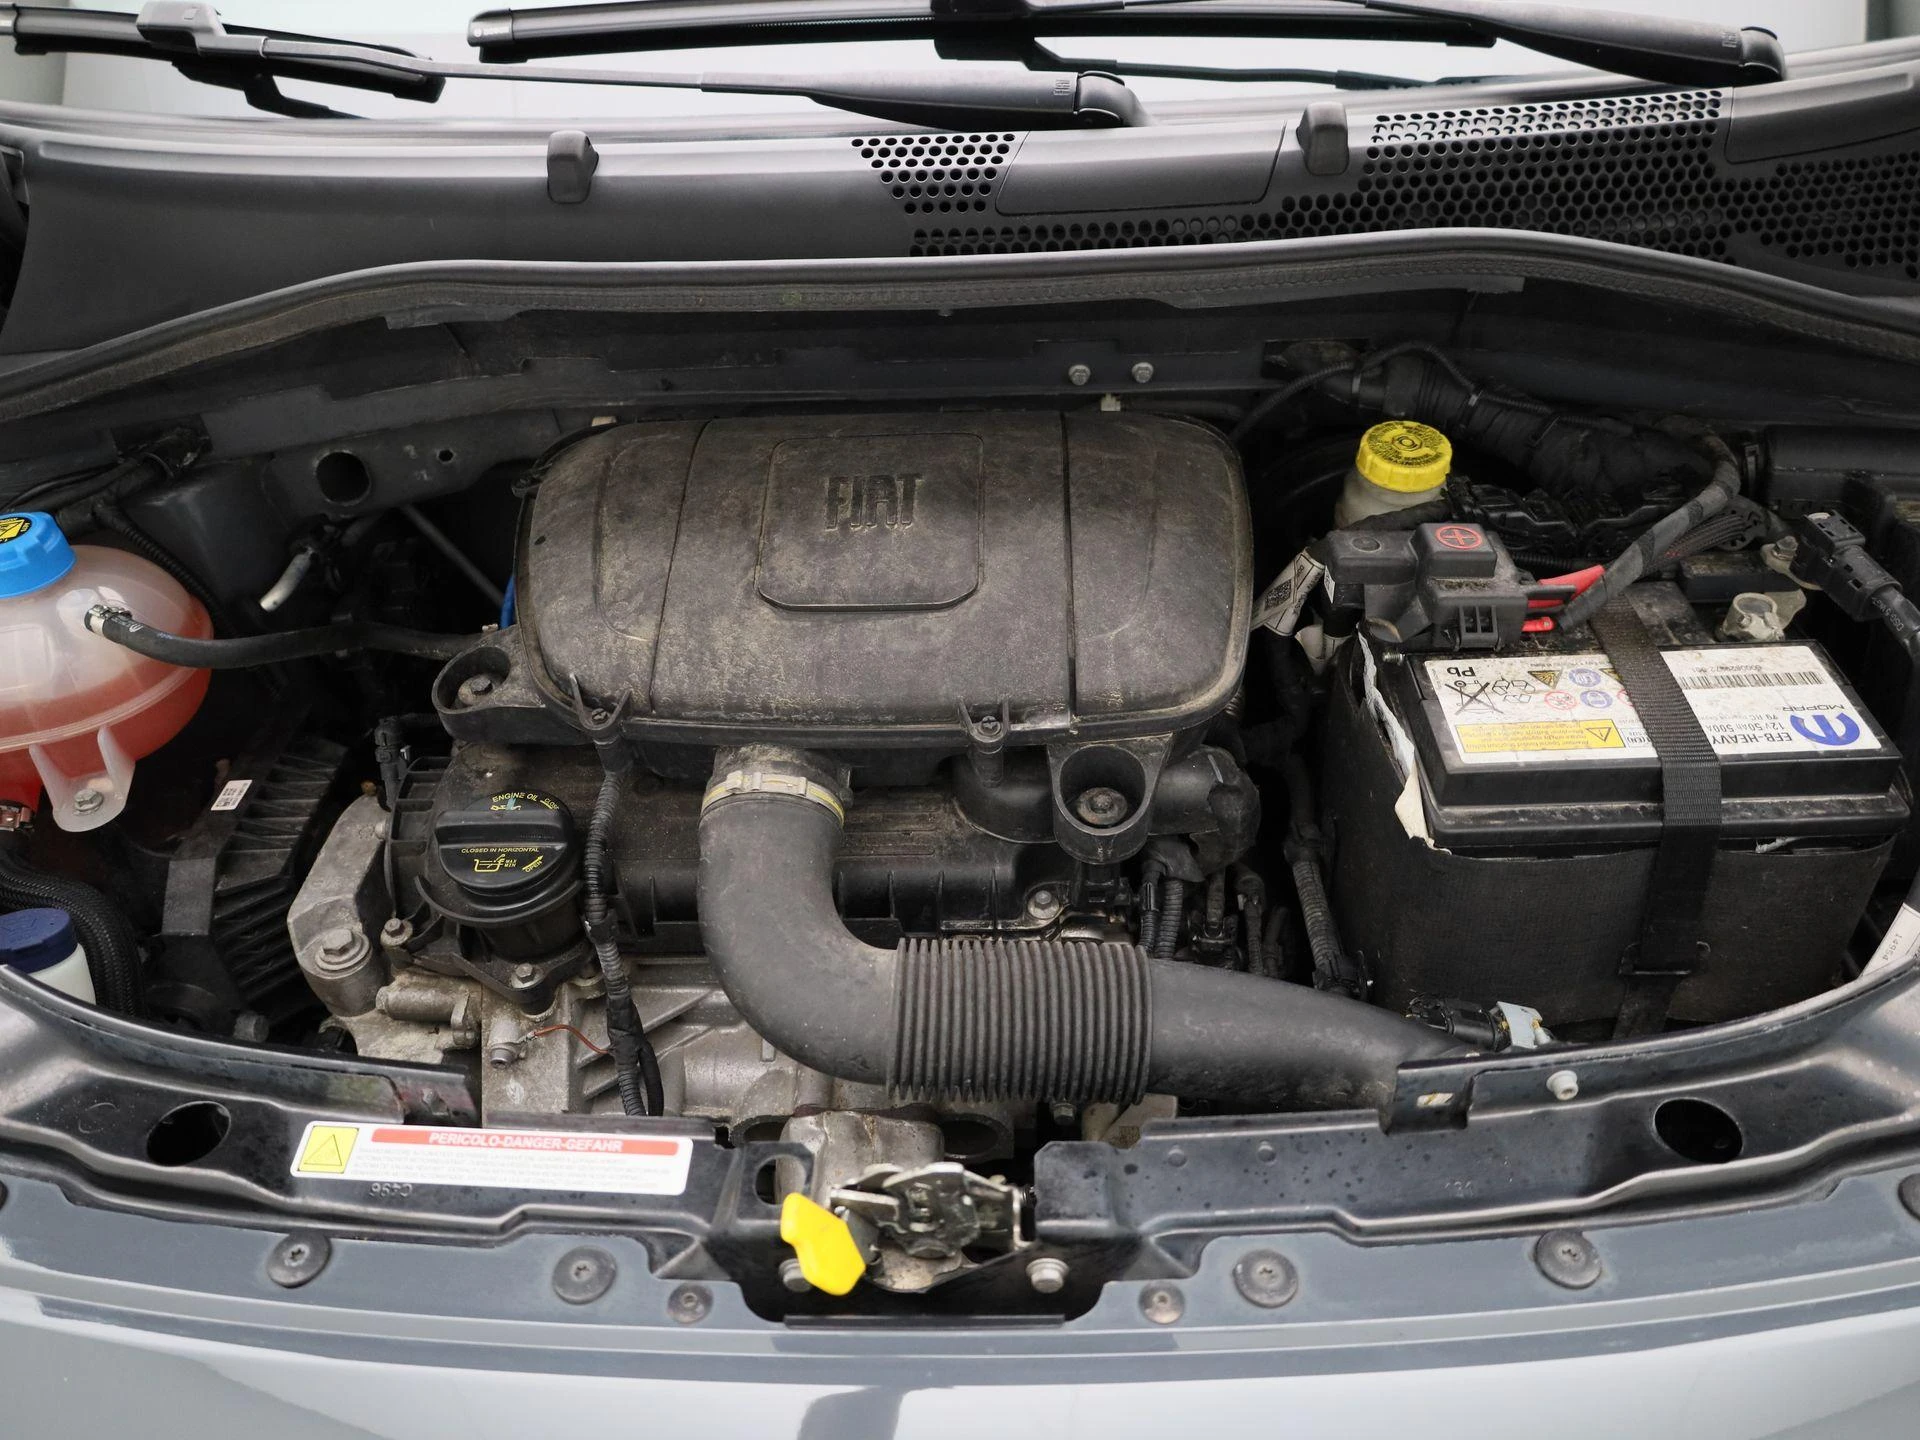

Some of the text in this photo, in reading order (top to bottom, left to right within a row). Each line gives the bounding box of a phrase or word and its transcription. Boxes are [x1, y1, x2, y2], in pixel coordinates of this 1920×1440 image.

[823, 472, 924, 532] FIAT
[1446, 666, 1477, 677] Pb
[1782, 704, 1845, 712] MOPAR
[1712, 732, 1793, 744] EFB-HEAVY
[492, 792, 539, 803] ENGINE OIL
[525, 860, 543, 873] OPEN
[428, 1131, 623, 1152] PERICOLO-DANGER-GEFAHR
